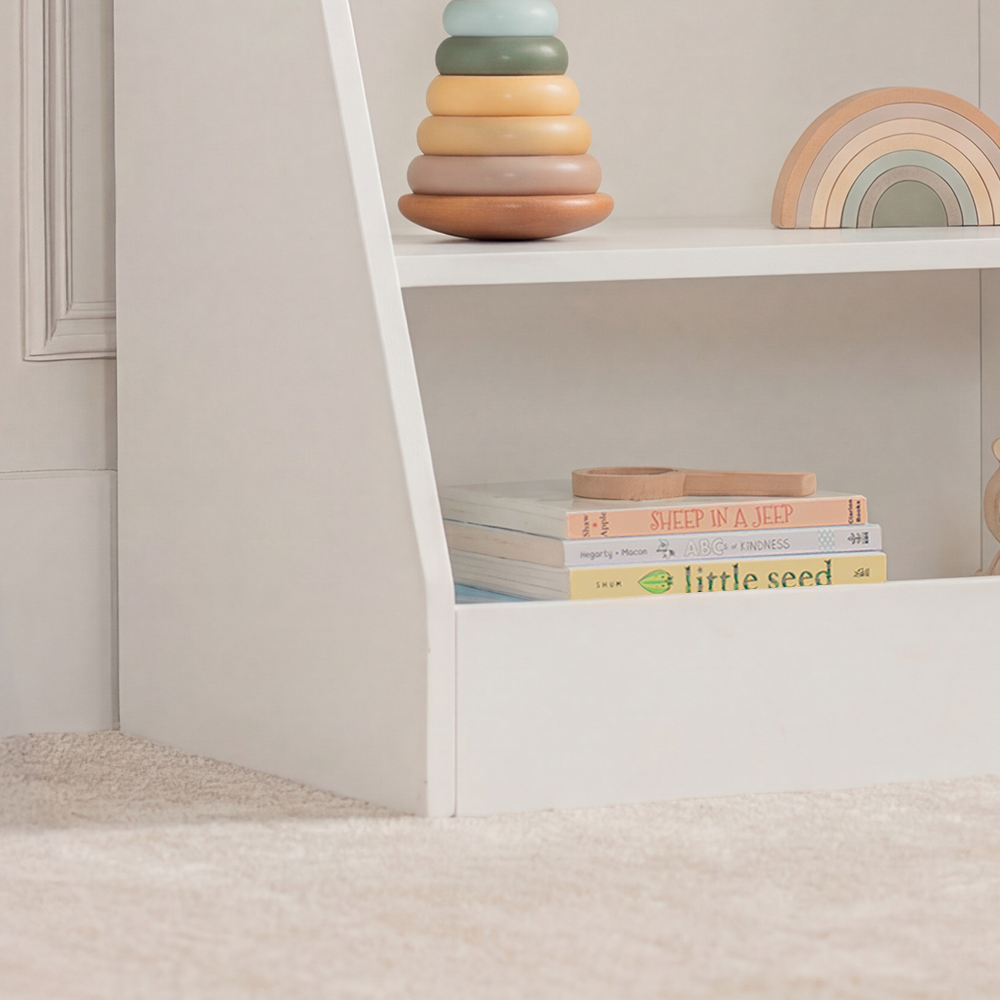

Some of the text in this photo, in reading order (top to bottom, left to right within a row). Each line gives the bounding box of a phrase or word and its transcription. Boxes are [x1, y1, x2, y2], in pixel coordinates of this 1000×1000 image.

[650, 503, 794, 531] SHEEP IN A JEEP
[684, 559, 832, 594] little seed
